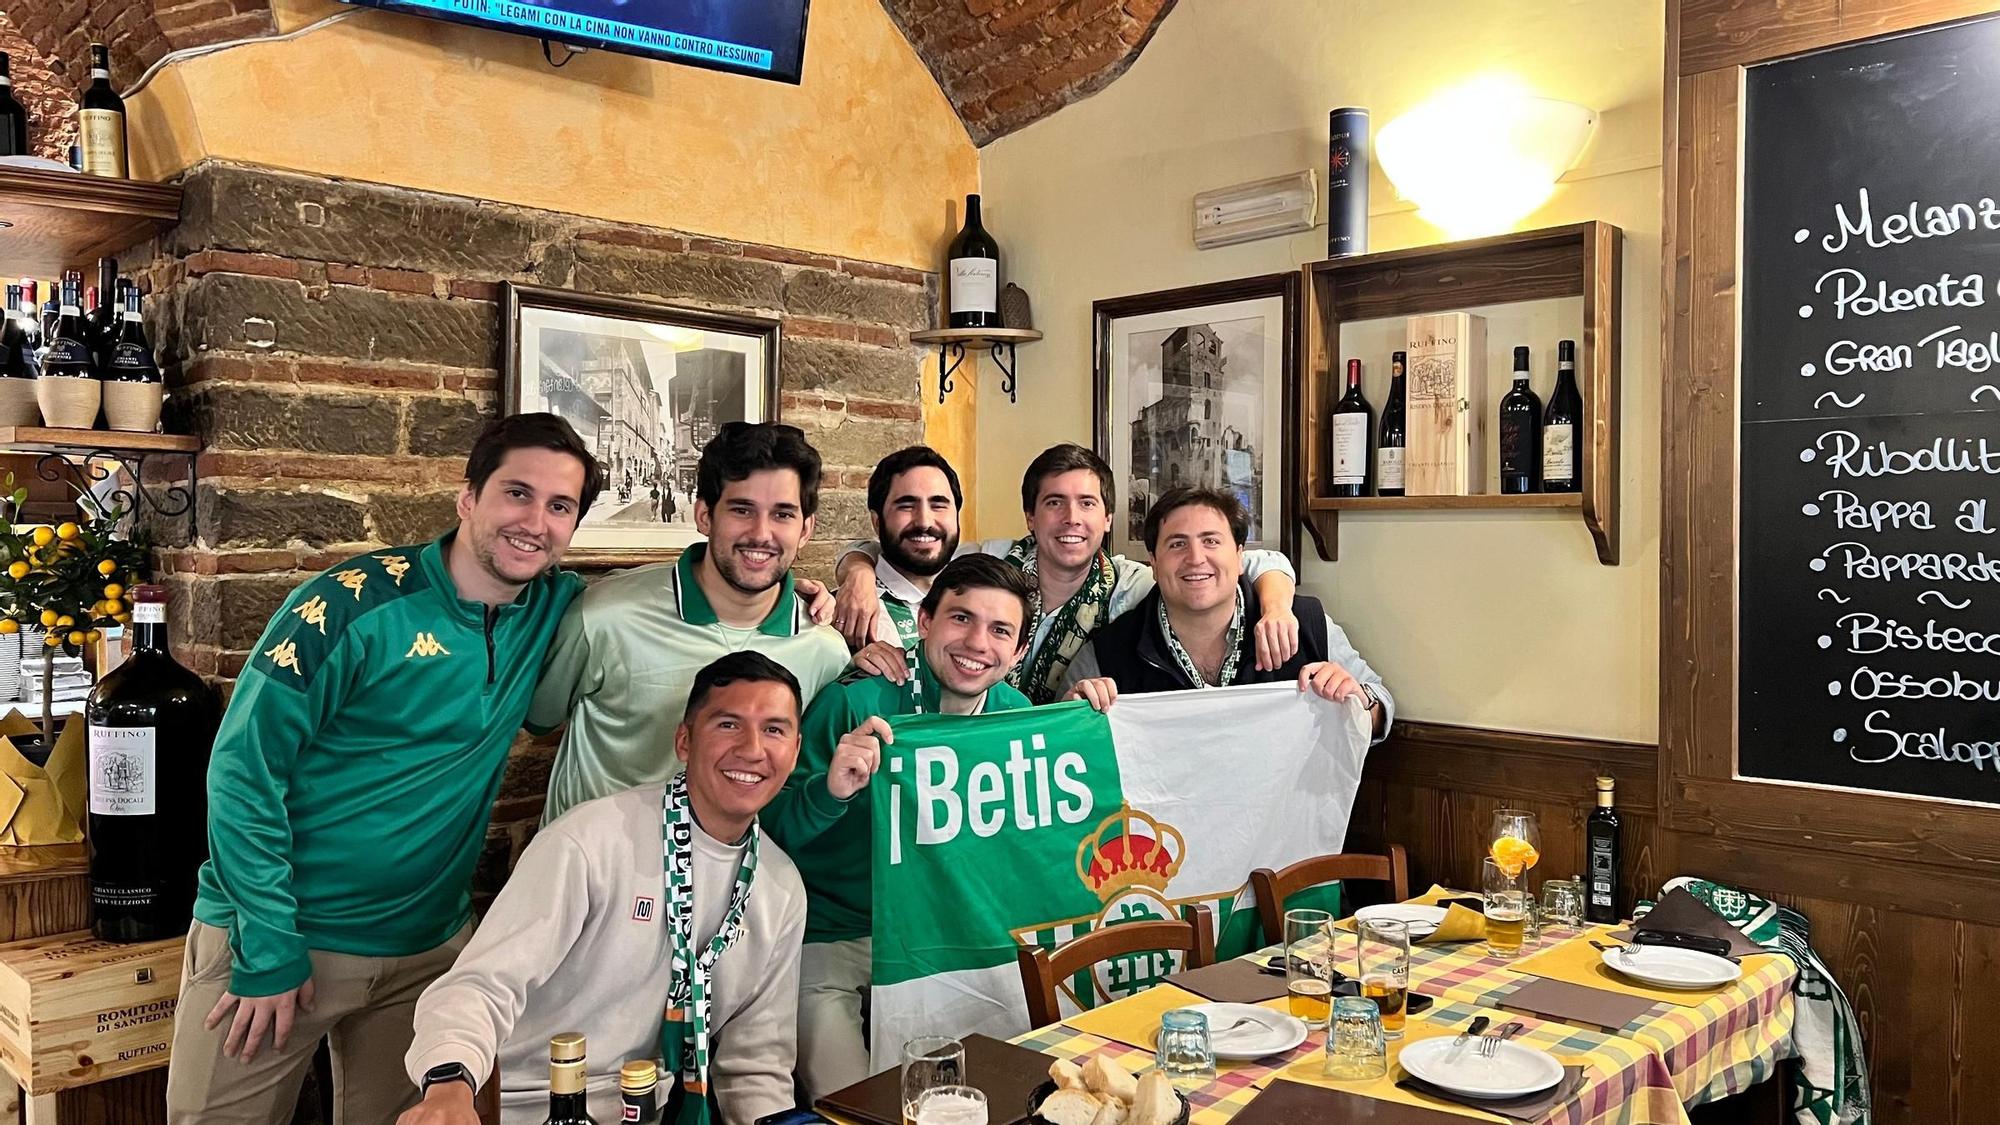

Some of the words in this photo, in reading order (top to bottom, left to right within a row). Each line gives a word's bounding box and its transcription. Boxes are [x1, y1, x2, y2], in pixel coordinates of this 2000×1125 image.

[544, 12, 566, 28] CON
[570, 16, 582, 30] LA
[585, 20, 610, 36] CINA
[614, 25, 635, 40] NON
[638, 29, 671, 47] VANNO
[674, 36, 713, 55] CONTRO
[716, 44, 765, 63] NESSUNO"
[1815, 268, 1986, 320] Polenta
[1818, 490, 1936, 532] Pappa
[1955, 499, 1996, 534] al
[93, 730, 147, 738] RUFFINO
[97, 999, 179, 1024] ROMITORI
[97, 1023, 110, 1034] DI
[118, 1042, 167, 1061] RUFFINO
